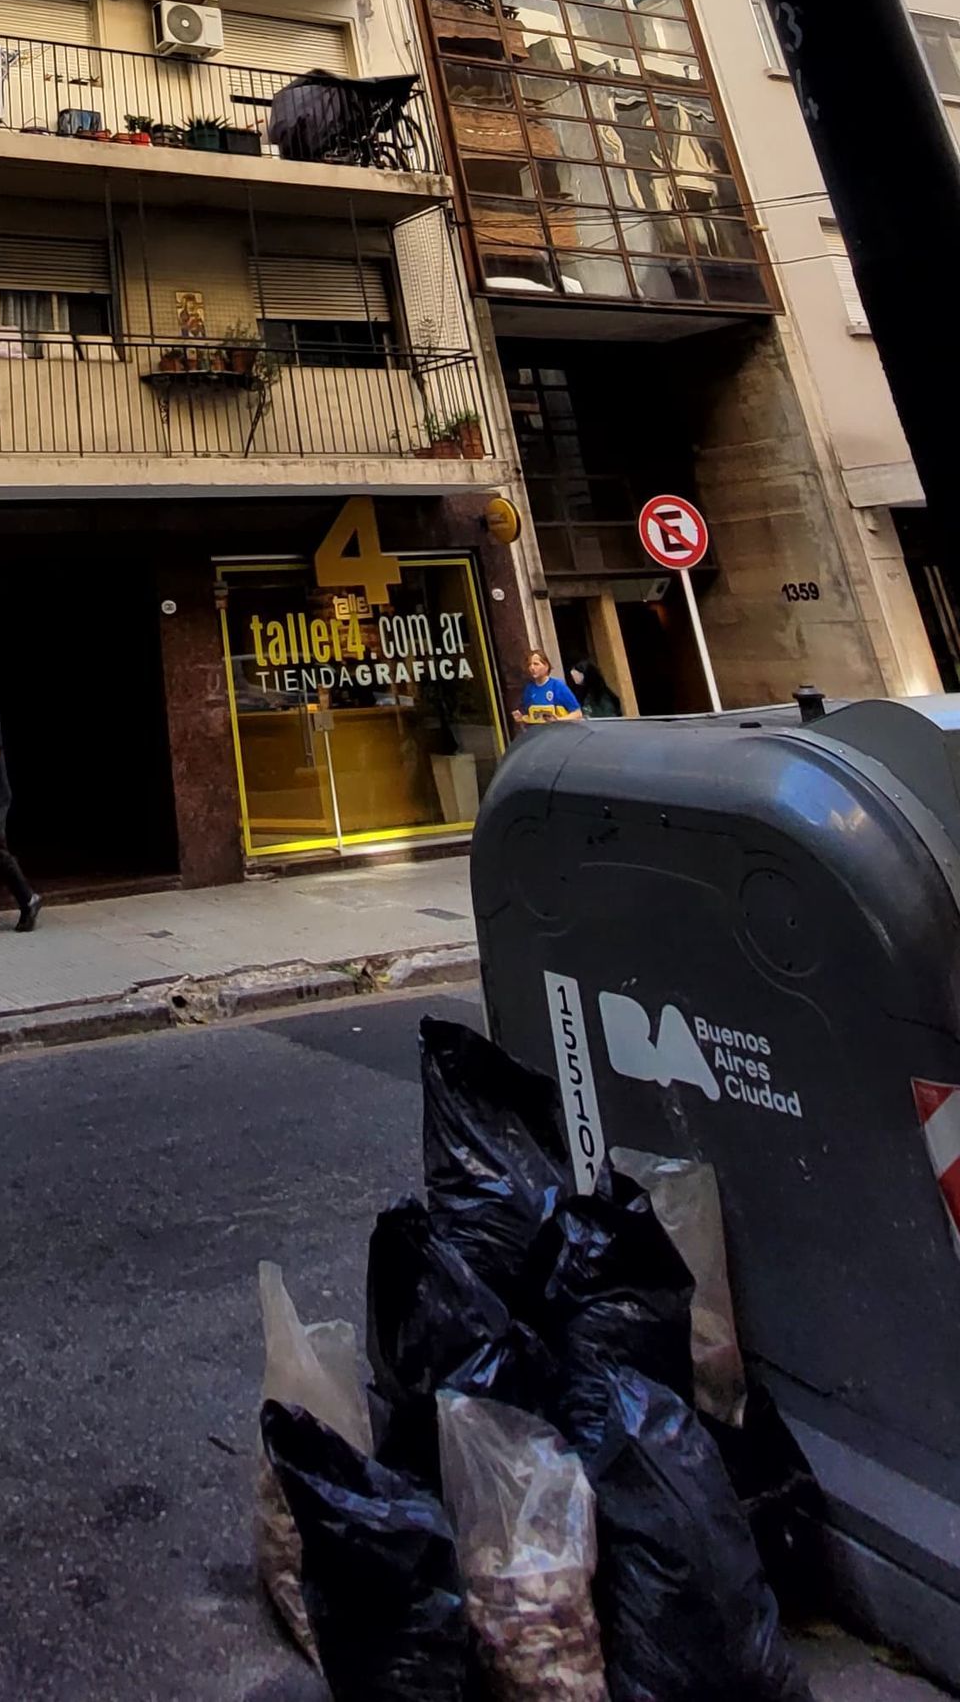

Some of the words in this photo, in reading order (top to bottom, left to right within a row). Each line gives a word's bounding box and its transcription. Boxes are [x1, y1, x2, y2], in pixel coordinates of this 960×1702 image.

[314, 496, 403, 605] 4
[656, 510, 693, 553] E
[781, 581, 820, 603] 1359
[250, 611, 465, 667] taller4.com.ar
[256, 657, 474, 693] TIENDAGRAFICA
[693, 1016, 772, 1057] Buenos
[714, 1048, 771, 1082] Aires
[724, 1074, 803, 1119] Ciudad
